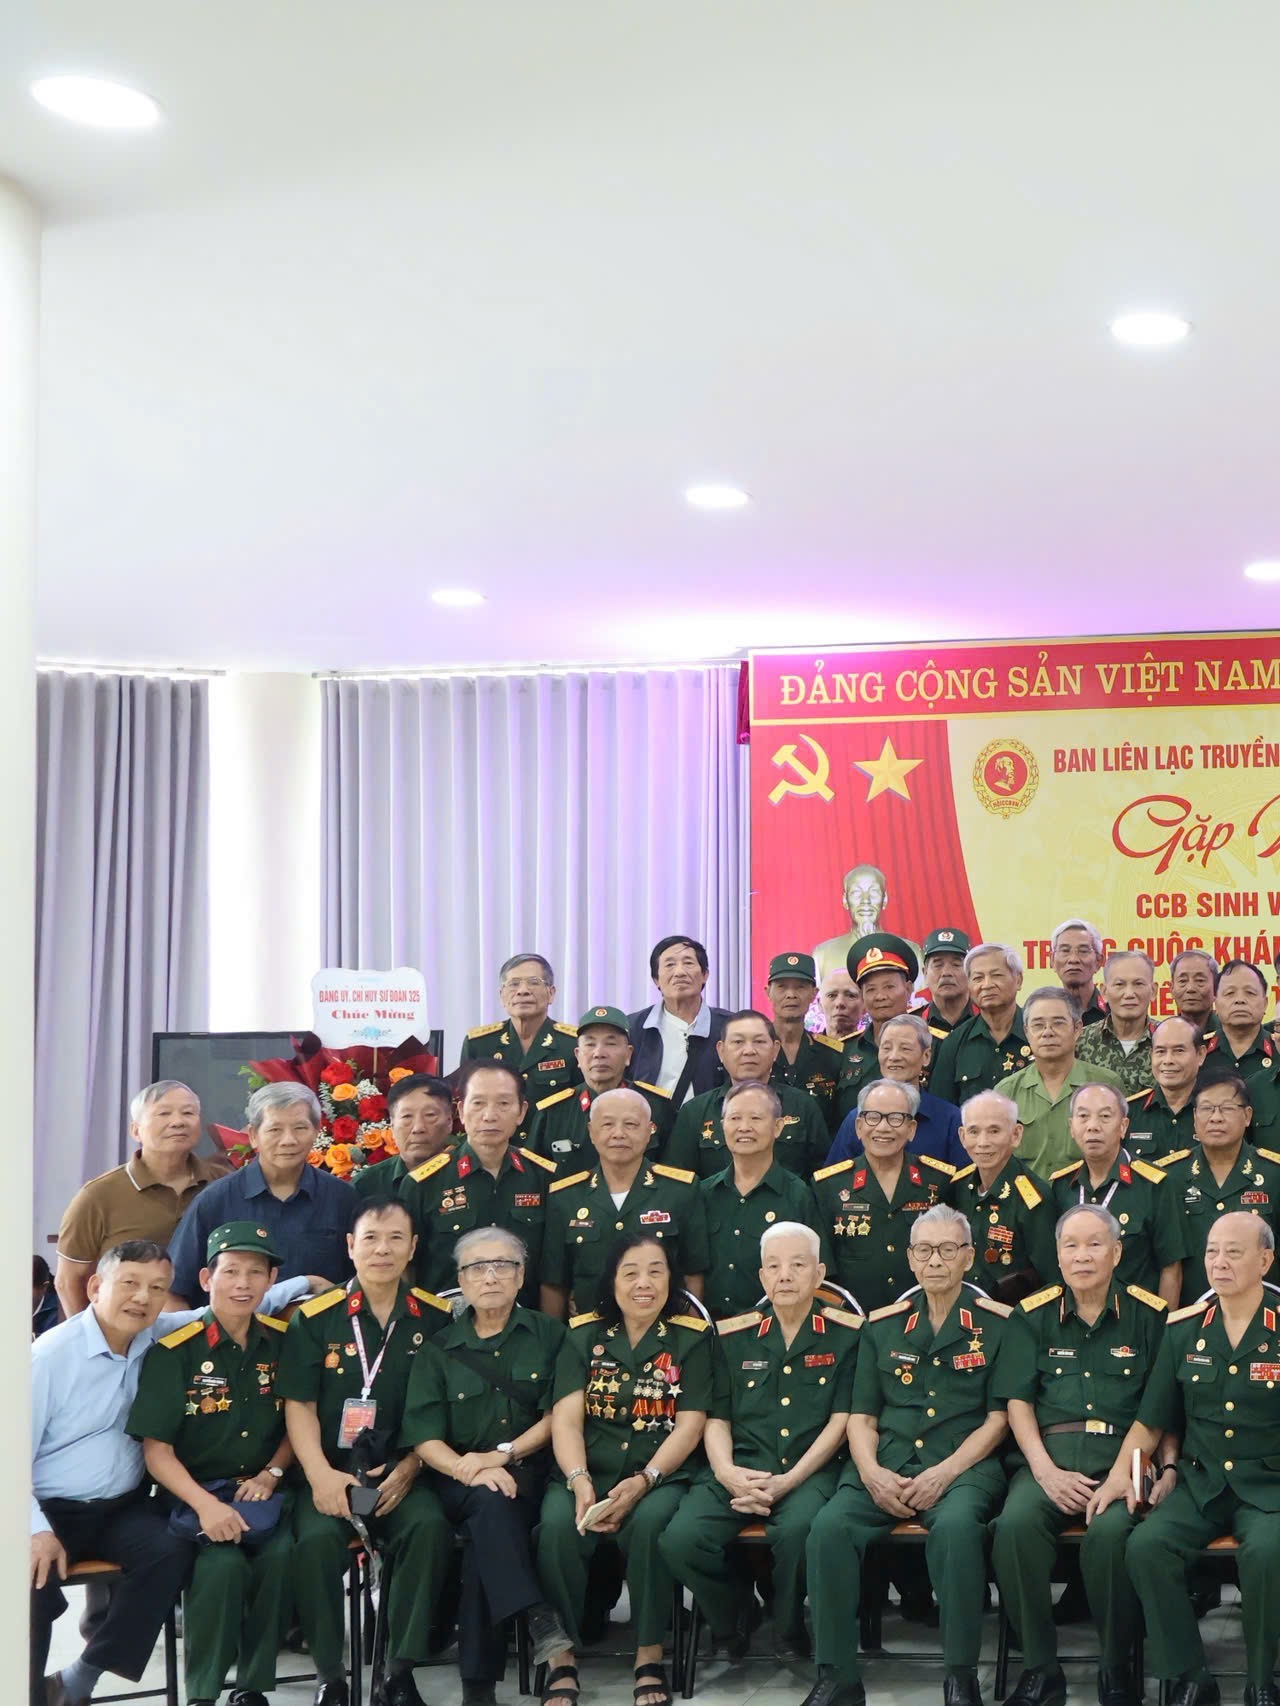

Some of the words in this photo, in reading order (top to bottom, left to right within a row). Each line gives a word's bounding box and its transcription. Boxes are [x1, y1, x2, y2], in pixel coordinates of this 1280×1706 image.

[780, 660, 885, 705] ĐẢNG
[896, 660, 997, 708] CỘNG
[1009, 652, 1083, 697] SẢN
[1096, 653, 1183, 700] VIỆT
[1055, 749, 1095, 772] BAN
[1104, 741, 1148, 770] LIÊN
[1156, 746, 1192, 775] LẠC
[1202, 736, 1279, 767] TRUYỀN
[1113, 795, 1234, 874] Gặp
[1138, 893, 1187, 917] CCB
[1198, 892, 1258, 916] SINH
[365, 990, 378, 1003] HUY
[408, 990, 421, 1003] 325
[331, 1007, 369, 1019] Chúc
[374, 1007, 416, 1020] Mừng
